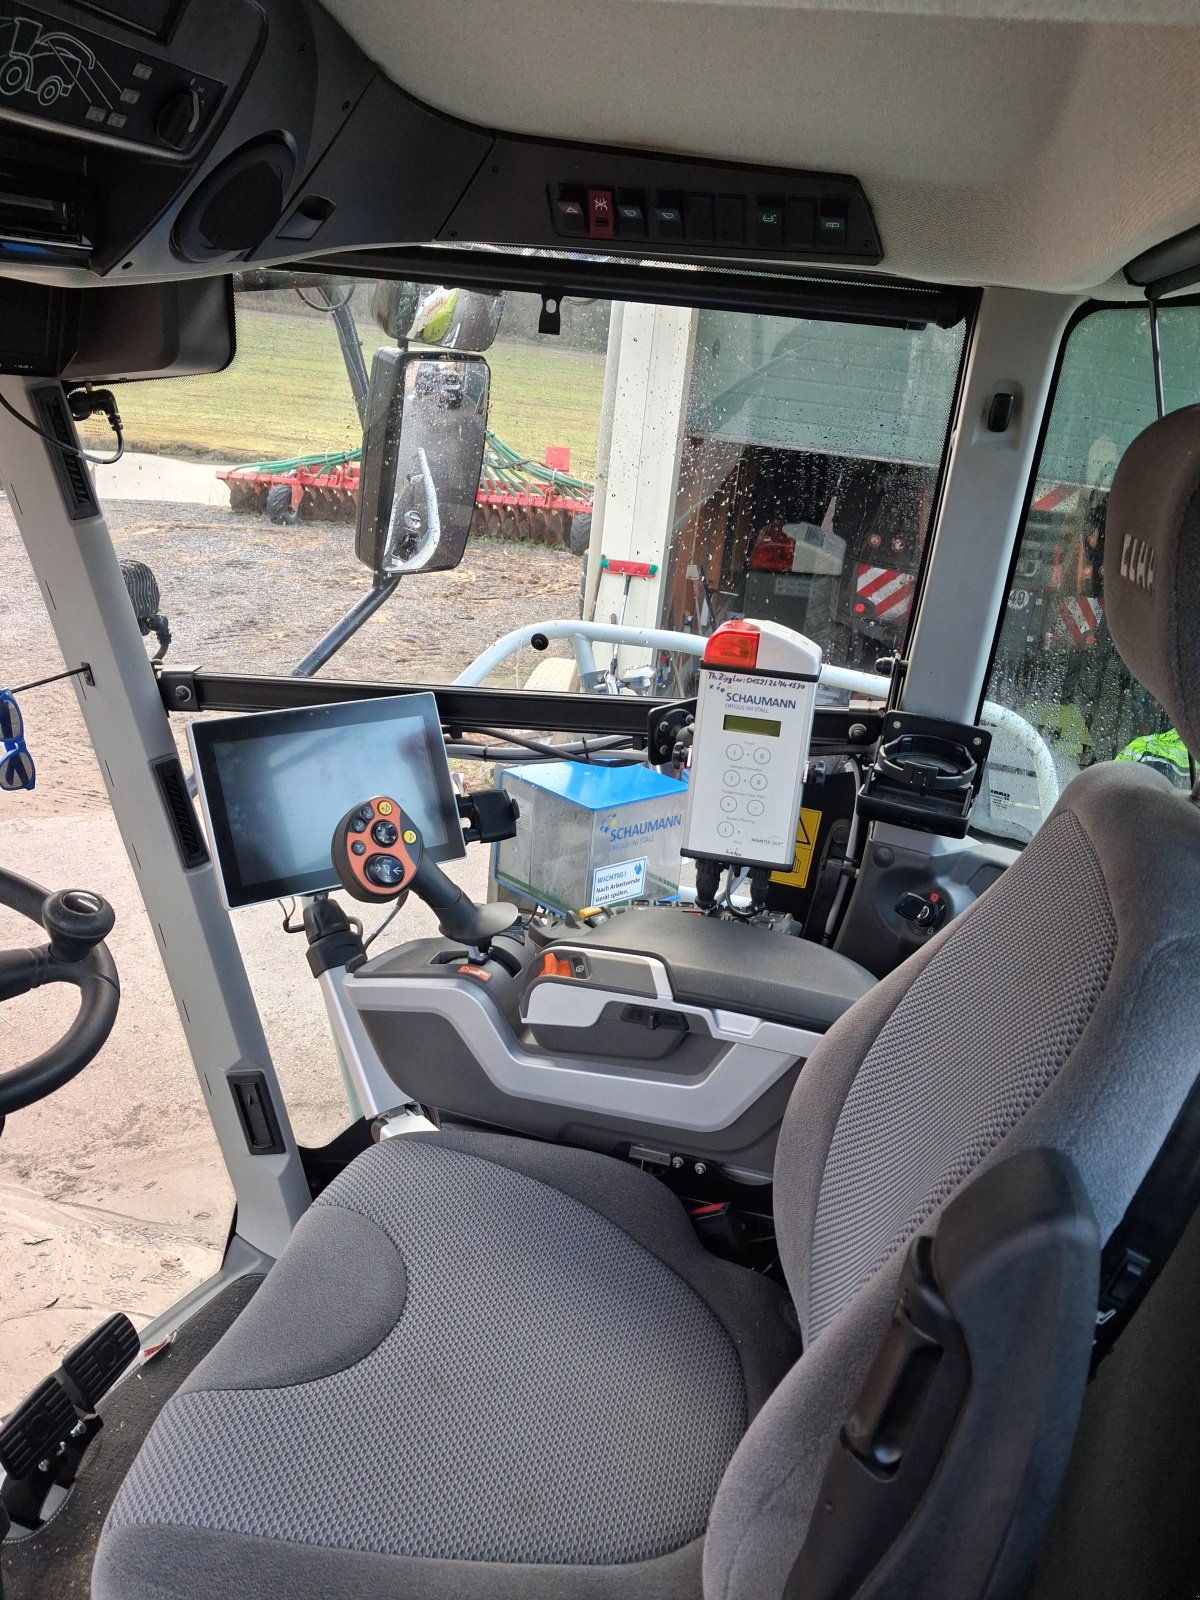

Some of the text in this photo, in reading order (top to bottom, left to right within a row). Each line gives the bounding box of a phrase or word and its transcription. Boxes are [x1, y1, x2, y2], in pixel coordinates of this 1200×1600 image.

[724, 703, 745, 711] ERFOLG
[725, 692, 797, 710] SCHAUMANN
[610, 814, 682, 842] SCHAUMANN
[608, 836, 655, 852] ERFOLG IM STALL
[596, 878, 641, 894] Nach Arbeitsende
[595, 889, 629, 902] Gerät spülen.
